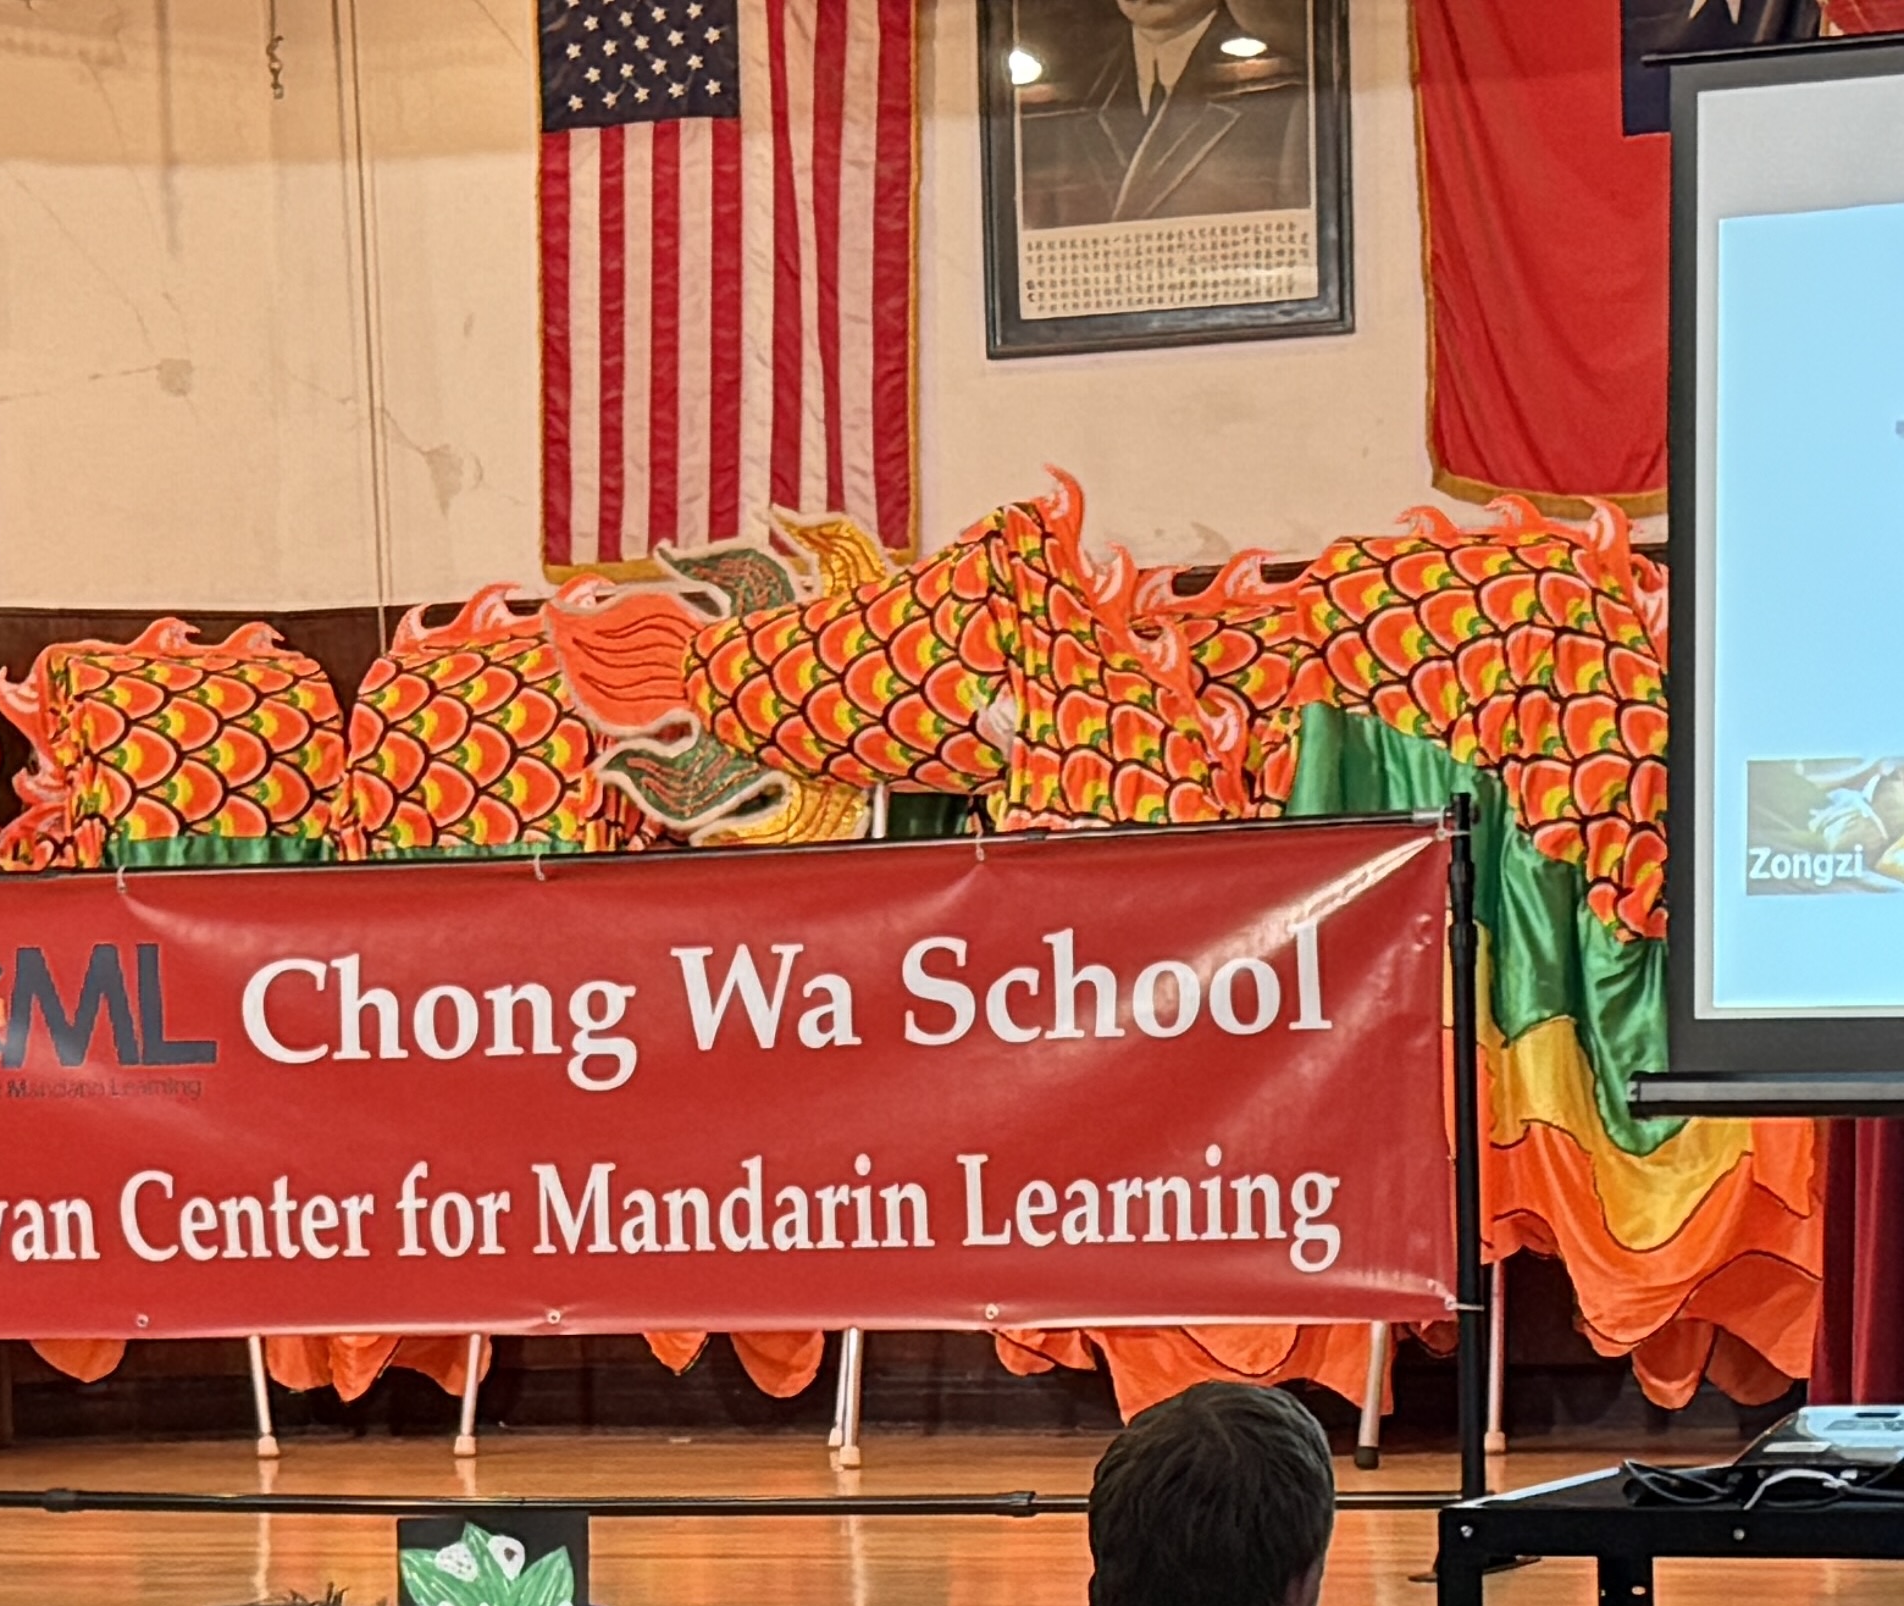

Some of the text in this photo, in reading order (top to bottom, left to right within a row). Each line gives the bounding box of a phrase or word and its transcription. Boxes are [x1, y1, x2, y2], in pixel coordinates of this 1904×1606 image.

[1748, 844, 1863, 886] Zongzi
[241, 922, 1335, 1090] Chong Wa School
[120, 1170, 375, 1261] Center
[396, 1161, 511, 1257] for
[532, 1154, 935, 1254] Mandarin
[958, 1144, 1342, 1273] Learning
